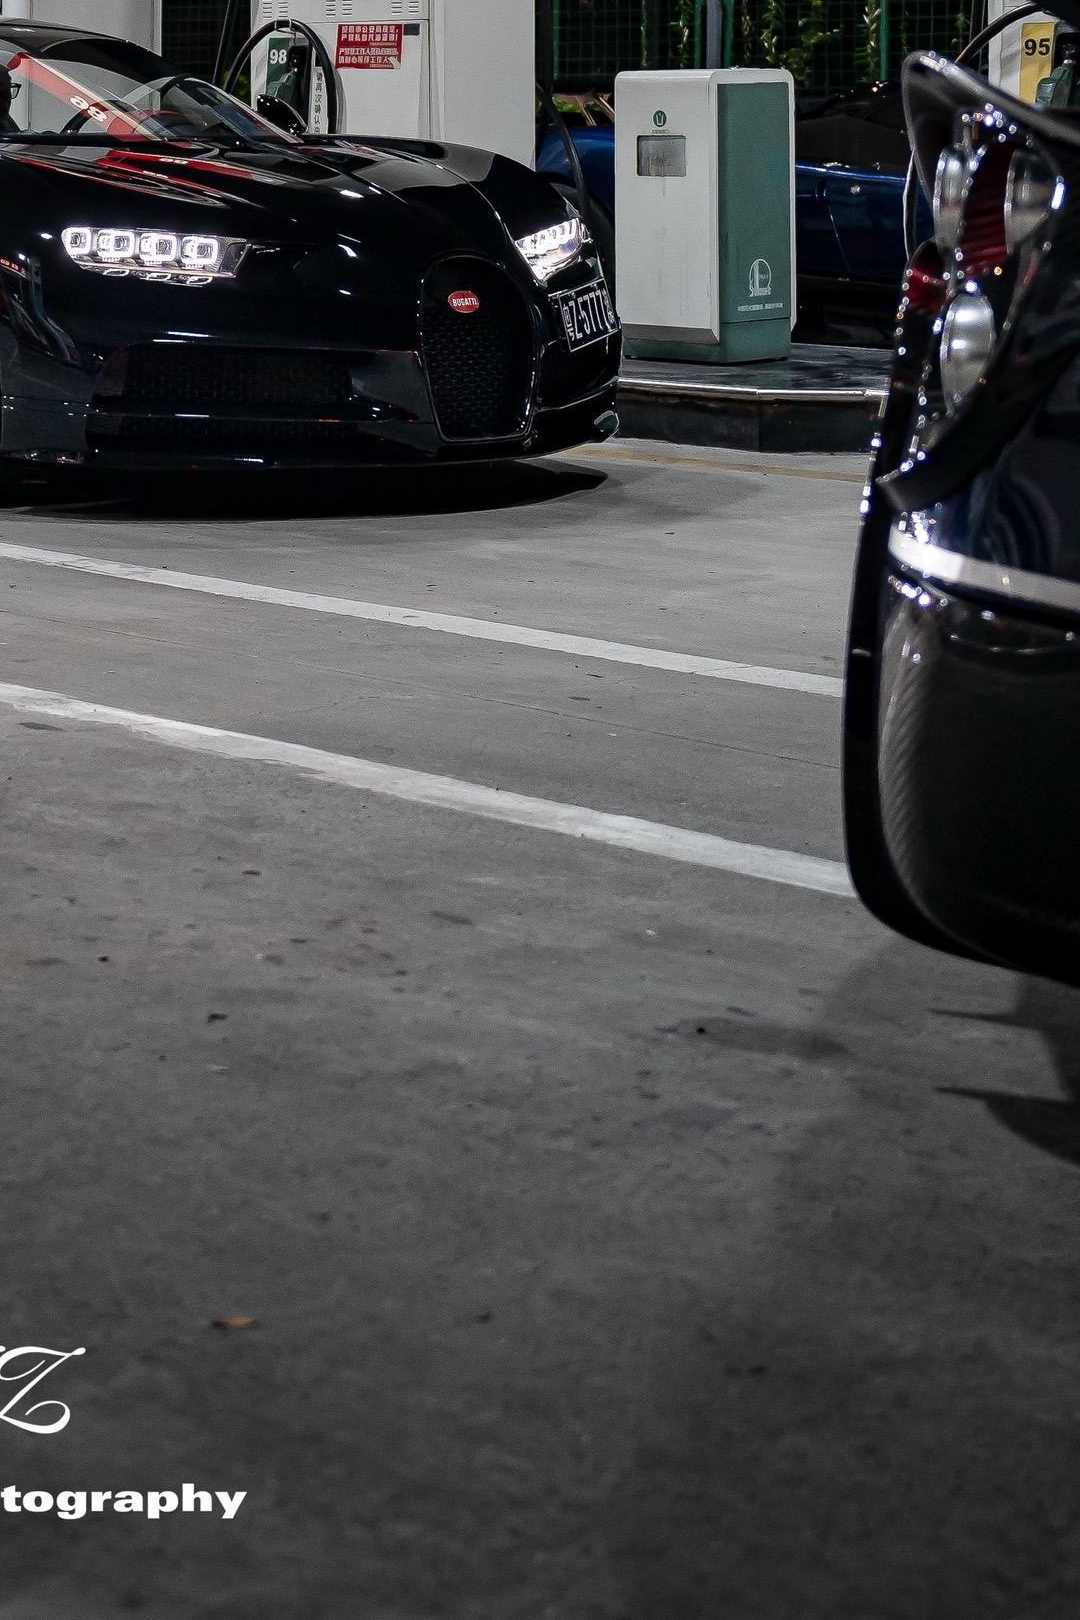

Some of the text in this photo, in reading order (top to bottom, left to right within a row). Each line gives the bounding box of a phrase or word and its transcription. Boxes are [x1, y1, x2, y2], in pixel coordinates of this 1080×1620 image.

[1024, 37, 1051, 57] 95
[269, 49, 287, 65] 98
[452, 297, 479, 307] BUGATTI
